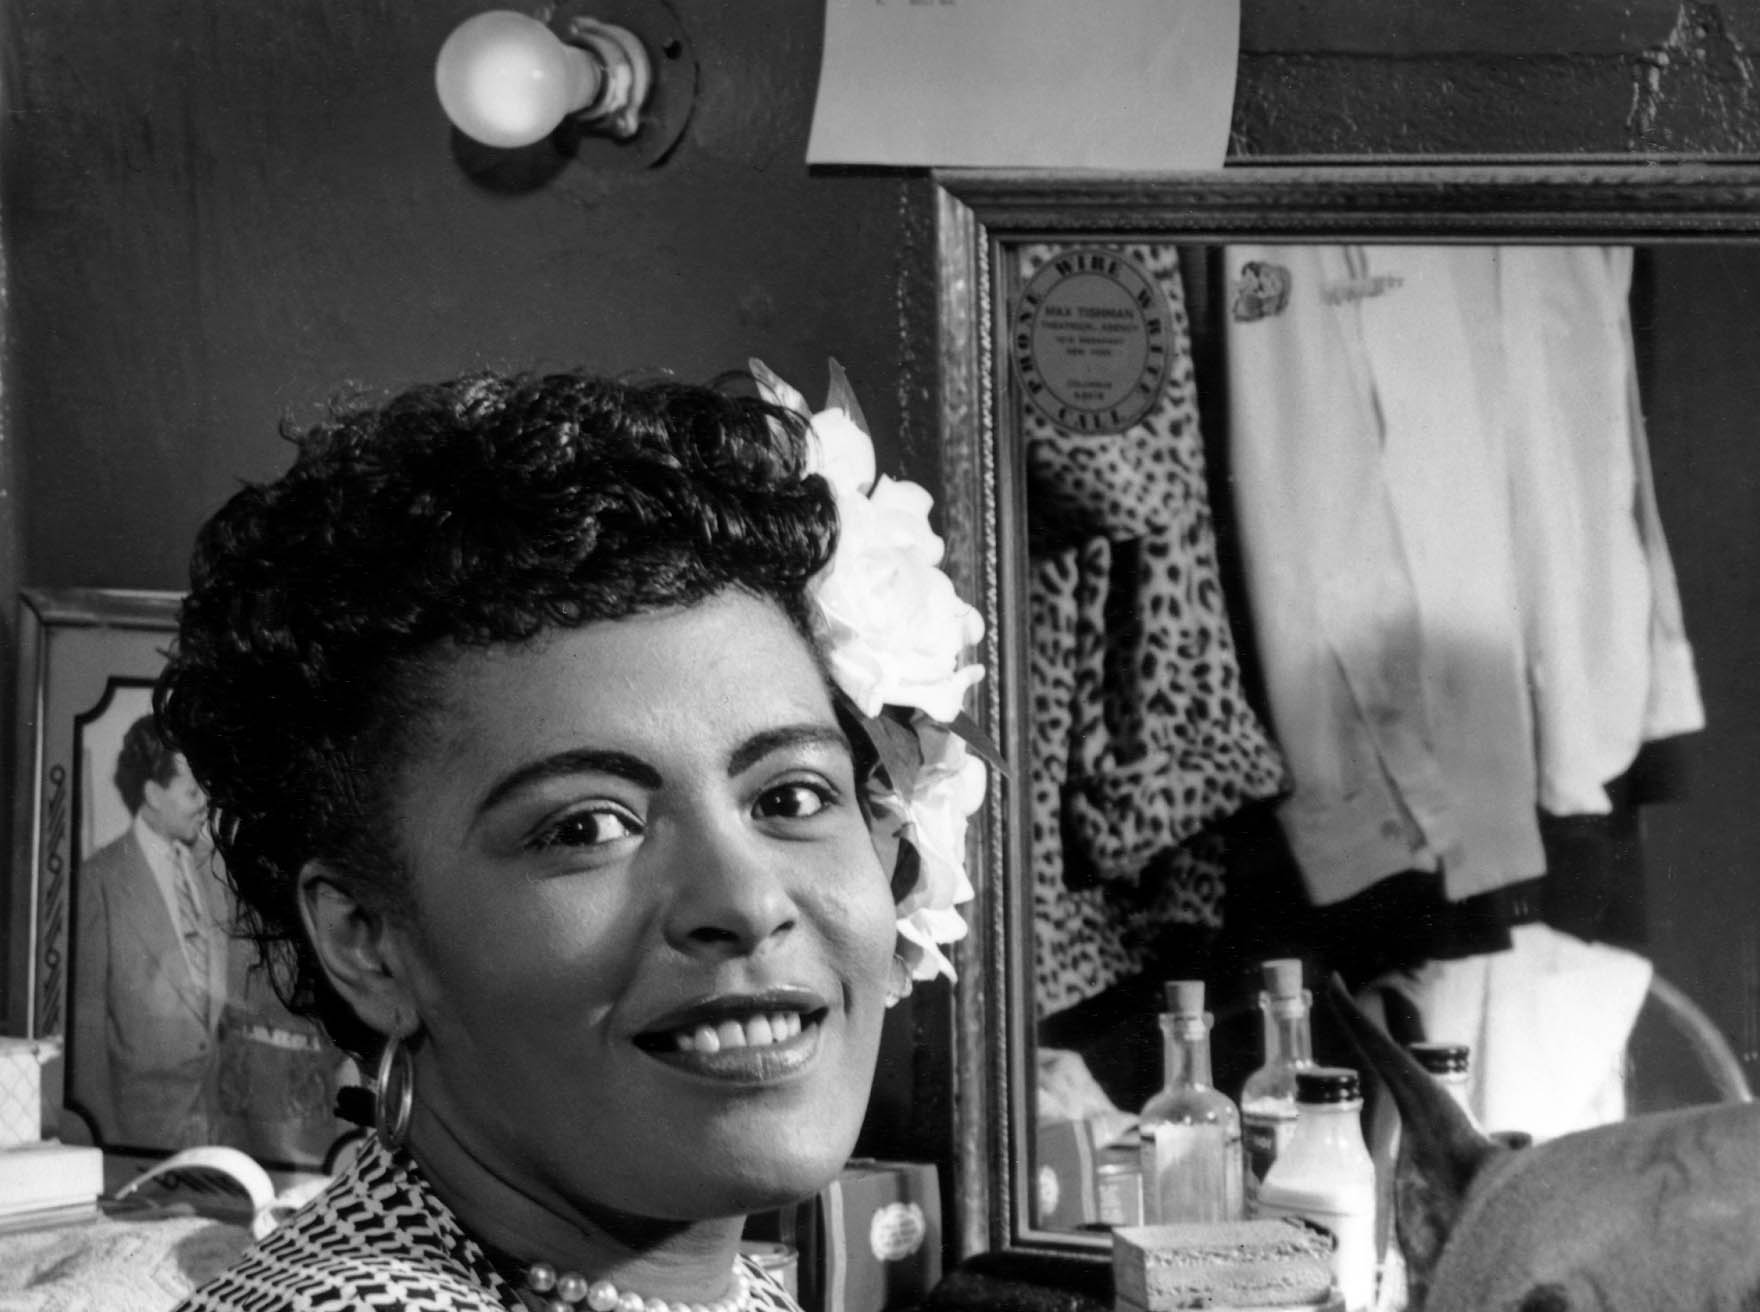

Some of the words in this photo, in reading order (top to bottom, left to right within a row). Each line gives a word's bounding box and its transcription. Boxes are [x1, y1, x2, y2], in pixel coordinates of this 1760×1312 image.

[1055, 255, 1118, 276] WIRE
[1017, 293, 1043, 395] PHONE
[1137, 287, 1164, 394] WRITE
